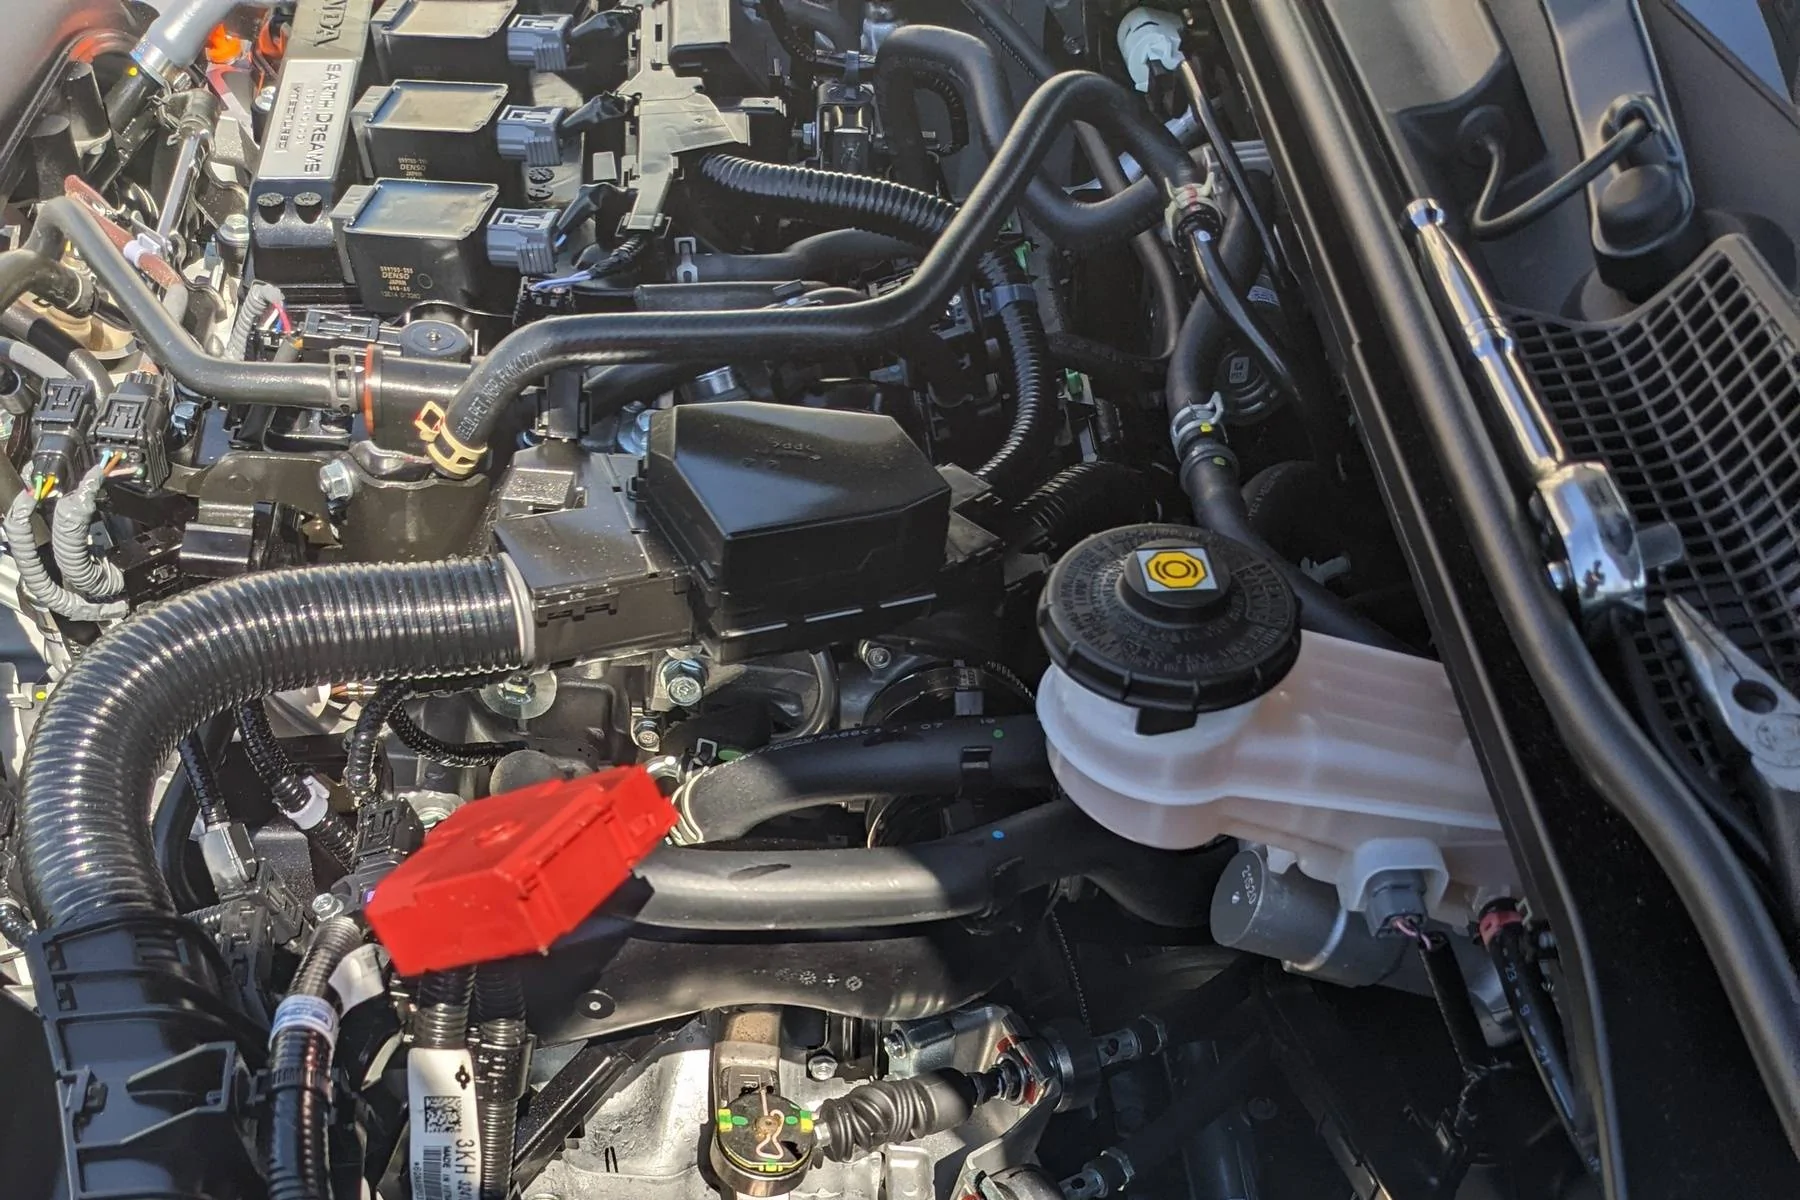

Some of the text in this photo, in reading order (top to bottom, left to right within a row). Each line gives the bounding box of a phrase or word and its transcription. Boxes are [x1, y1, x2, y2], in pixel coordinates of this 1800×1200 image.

[304, 63, 342, 174] EARTH DREAMS
[399, 163, 427, 172] DENSO
[381, 271, 411, 281] DENSO
[443, 1145, 453, 1169] MADE
[455, 1138, 477, 1175] 3KH
[443, 1173, 452, 1184] IN
